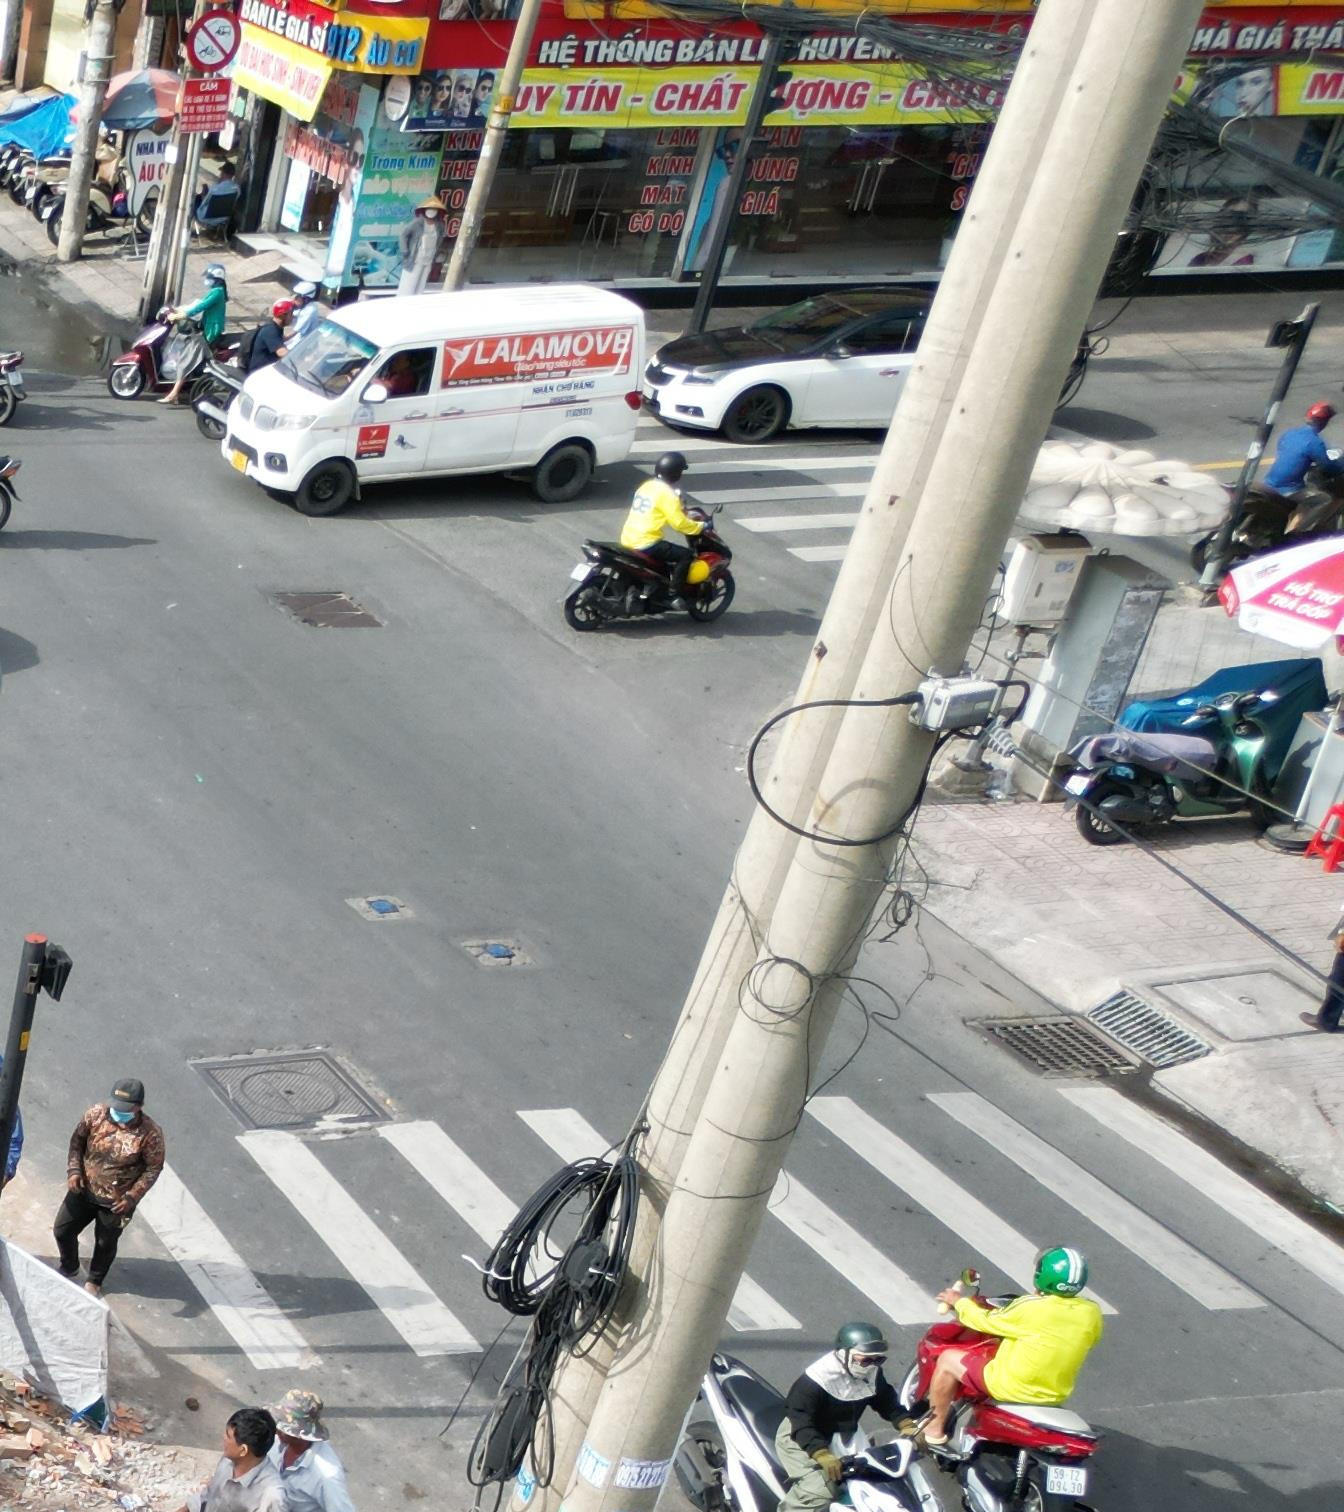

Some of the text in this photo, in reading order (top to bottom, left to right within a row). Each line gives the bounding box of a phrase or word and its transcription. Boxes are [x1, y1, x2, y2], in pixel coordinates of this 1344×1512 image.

[326, 24, 360, 62] 912
[539, 34, 579, 69] HỆ
[583, 28, 673, 63] THỐNG
[675, 33, 737, 63] BÁN
[562, 78, 623, 113] TÍN
[654, 73, 747, 112] CHẤT
[774, 79, 871, 117] ƯỢNG
